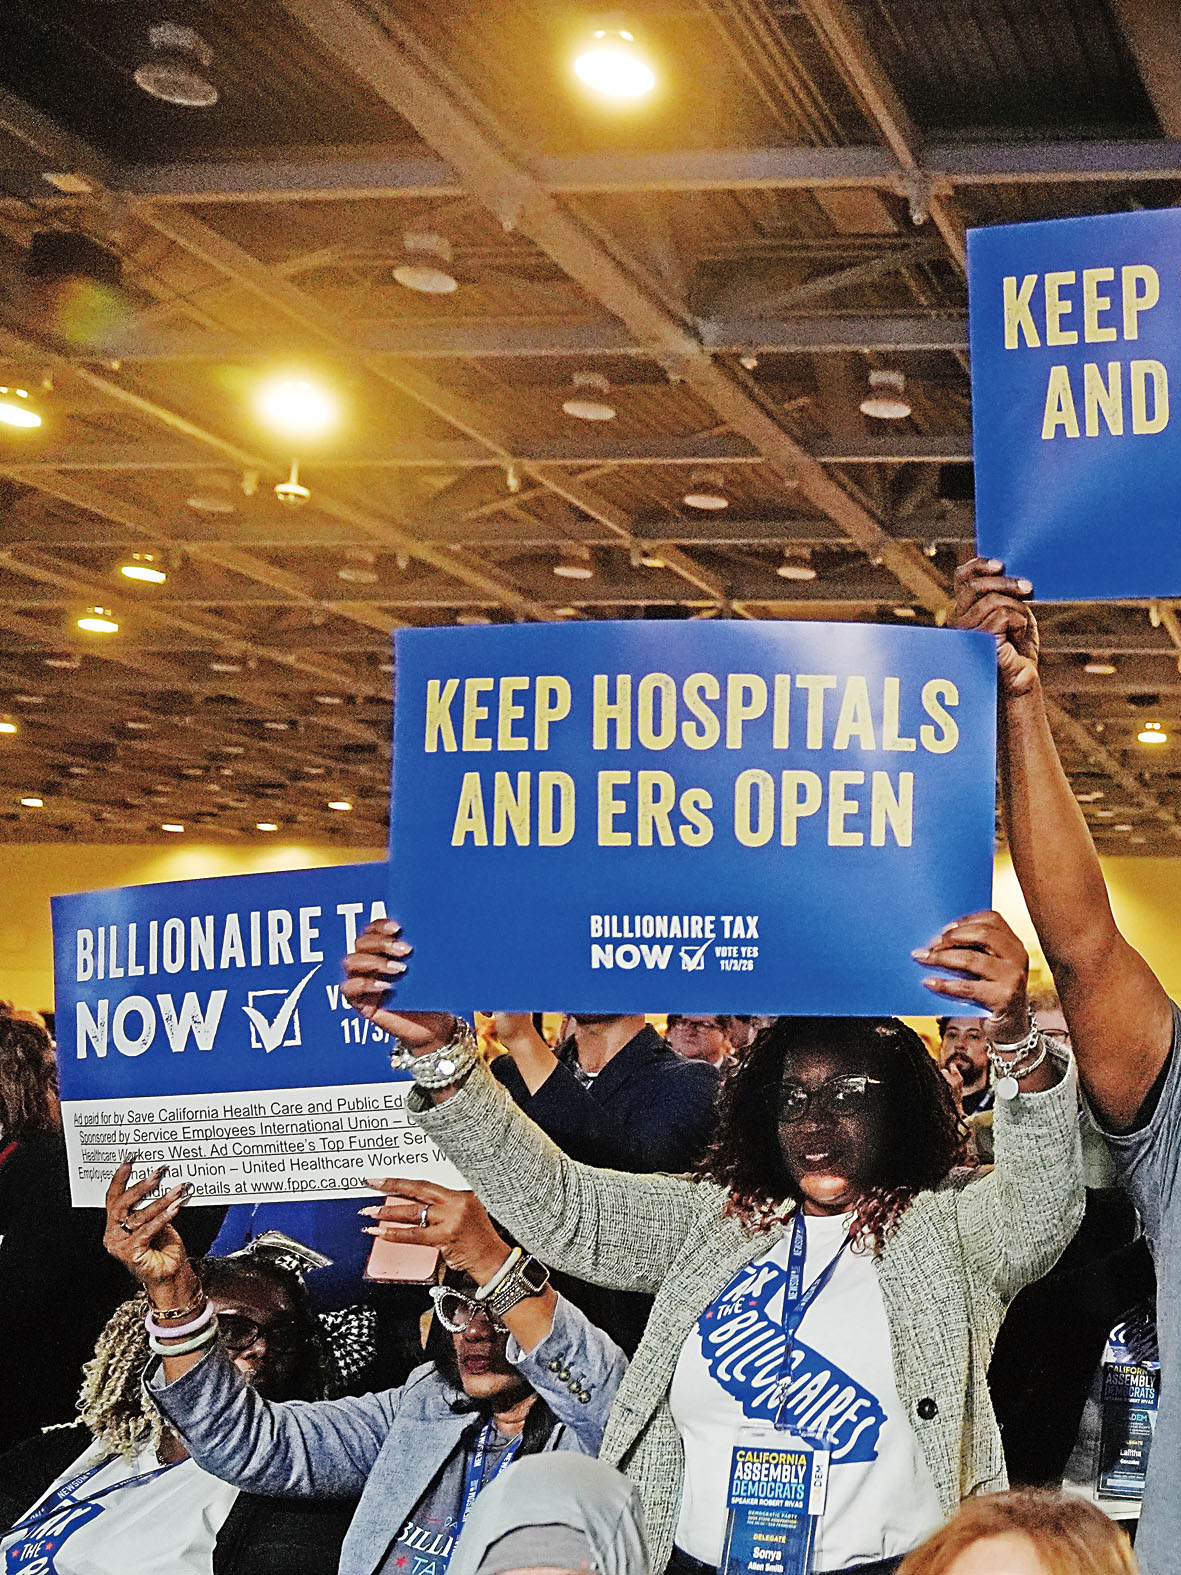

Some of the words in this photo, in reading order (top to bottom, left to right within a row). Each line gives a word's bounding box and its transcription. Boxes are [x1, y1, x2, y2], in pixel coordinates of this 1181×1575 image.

[1003, 264, 1161, 349] KEEP
[1041, 359, 1169, 439] AND
[424, 675, 572, 753] KEEP
[592, 672, 959, 754] HOSPITALS
[451, 771, 575, 847] AND
[598, 770, 713, 847] ERs
[733, 769, 913, 847] OPEN
[590, 915, 716, 938] BILLIONAIRE
[721, 915, 759, 938] TAX
[76, 905, 324, 982] BILLIONAIRE
[715, 947, 739, 957] VOTE
[741, 946, 759, 957] YES
[591, 944, 674, 970] NOW
[76, 990, 228, 1060] NOW
[74, 1113, 83, 1124] Ad
[85, 1112, 99, 1126] paid
[101, 1112, 112, 1123] for
[114, 1111, 124, 1126] by
[127, 1110, 155, 1123] Save
[158, 1106, 218, 1121] California
[223, 1103, 266, 1118] Health
[271, 1102, 303, 1115] Care
[308, 1099, 332, 1112] and
[337, 1096, 379, 1112] Public
[79, 1130, 116, 1144] Sponsored
[119, 1130, 130, 1144] by
[133, 1128, 178, 1142] Service
[182, 1124, 256, 1140] Employees
[260, 1117, 344, 1135] International
[348, 1116, 389, 1130] Union
[82, 1148, 116, 1162] Healthcare
[168, 1146, 206, 1159] West.
[210, 1143, 228, 1157] Ad
[232, 1138, 316, 1156] Committee’s
[320, 1137, 344, 1152] Top
[349, 1134, 399, 1149] Funder
[187, 1162, 226, 1177] Union
[242, 1158, 285, 1174] United
[290, 1155, 364, 1171] Healthcare
[368, 1151, 429, 1166] Workers
[235, 1180, 247, 1193] at
[717, 1298, 746, 1320] THE
[1105, 1373, 1156, 1388] ASSEMBLY
[736, 1450, 807, 1465] CALIFORNIA
[733, 1461, 807, 1484] ASSEMBLY
[57, 1474, 88, 1499] NEWSOM
[731, 1479, 805, 1500] DEMOCRATS
[731, 1497, 758, 1506] SPEAKER
[759, 1499, 784, 1507] ROBERT
[784, 1501, 803, 1509] RIVAS
[20, 1540, 46, 1561] THE
[753, 1533, 787, 1544] DELEGATE
[753, 1546, 782, 1562] Sonya
